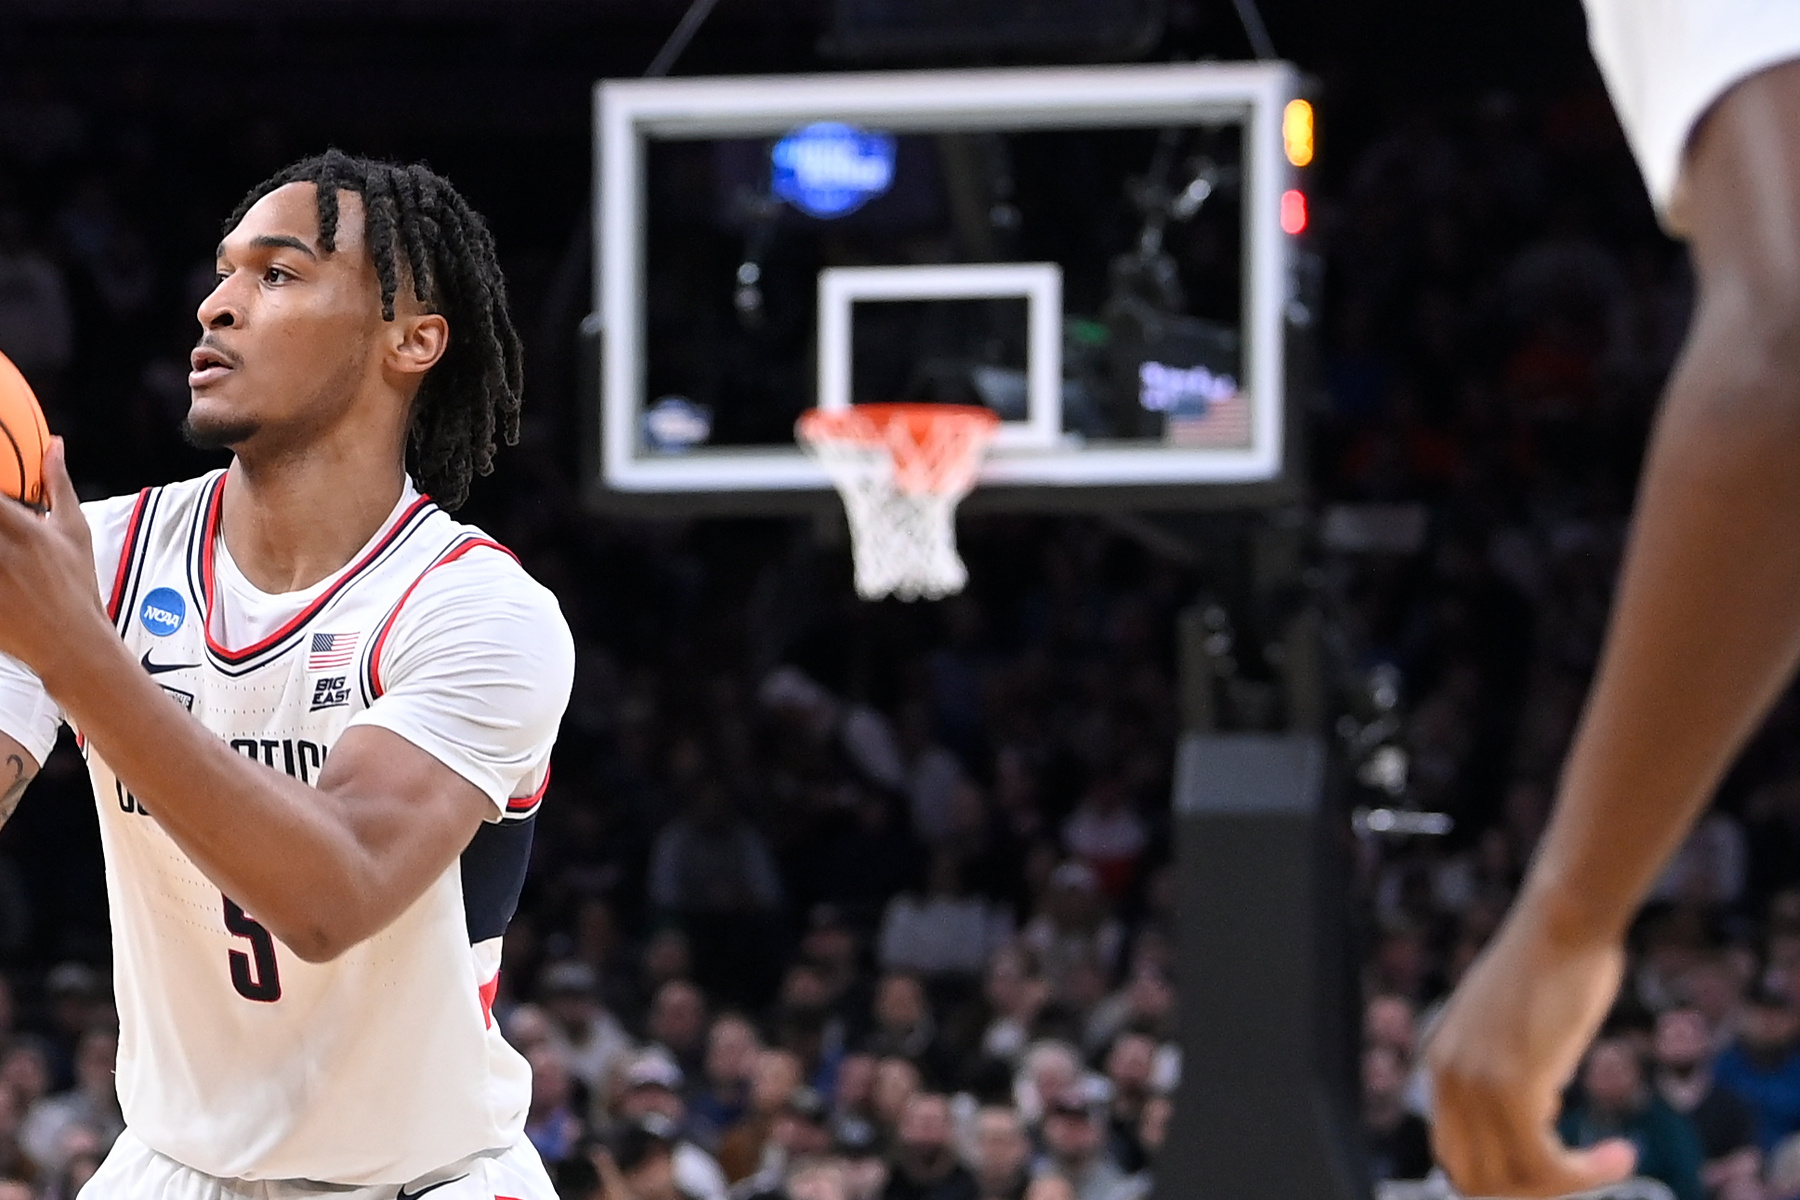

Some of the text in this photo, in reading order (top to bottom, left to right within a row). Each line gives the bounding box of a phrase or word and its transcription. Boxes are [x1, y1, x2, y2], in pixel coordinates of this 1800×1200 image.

[144, 605, 180, 628] NCAA
[315, 676, 346, 691] BIG
[312, 688, 351, 704] EAST
[221, 892, 281, 1002] 5
